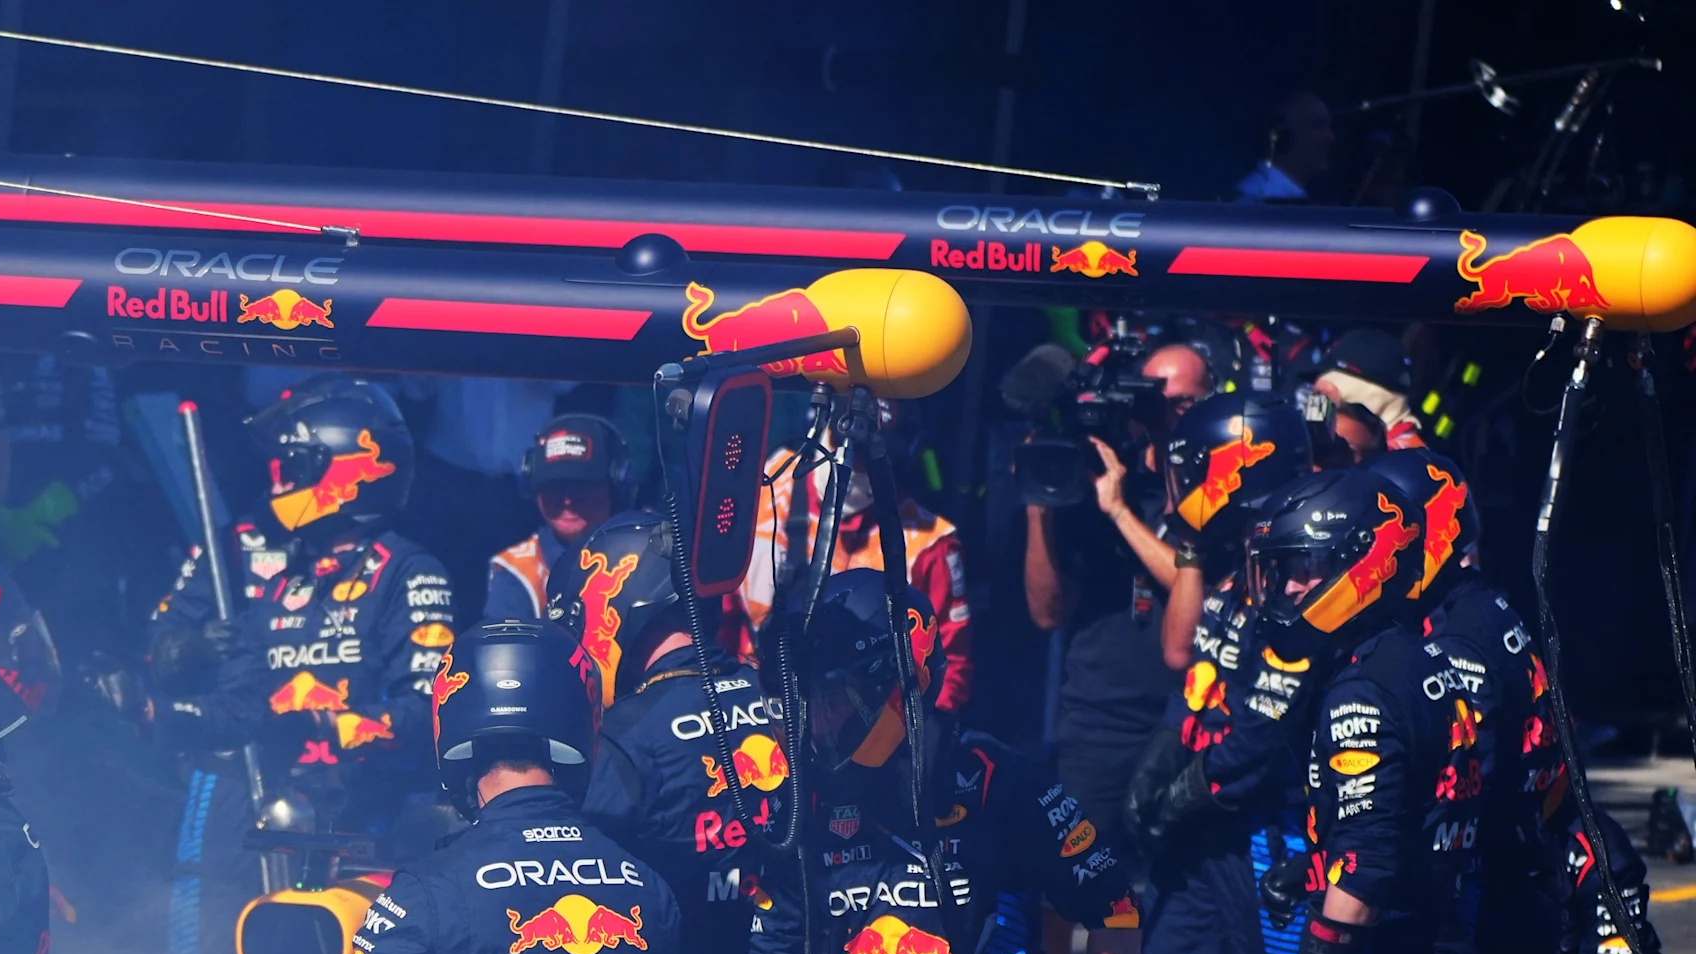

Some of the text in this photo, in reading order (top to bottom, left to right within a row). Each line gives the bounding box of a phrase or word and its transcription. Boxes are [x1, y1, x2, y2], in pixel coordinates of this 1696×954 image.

[936, 204, 1146, 239] ORACLE
[114, 247, 345, 285] ORACLE
[930, 239, 1041, 272] Red Bull
[107, 286, 227, 324] Red Bull
[112, 334, 342, 360] RACING
[267, 639, 363, 670] ORACLE
[1330, 701, 1381, 720] infinitum
[1330, 715, 1381, 742] ROKT
[522, 825, 583, 843] sparco
[475, 857, 644, 888] ORACLE
[828, 878, 972, 917] ORACLE
